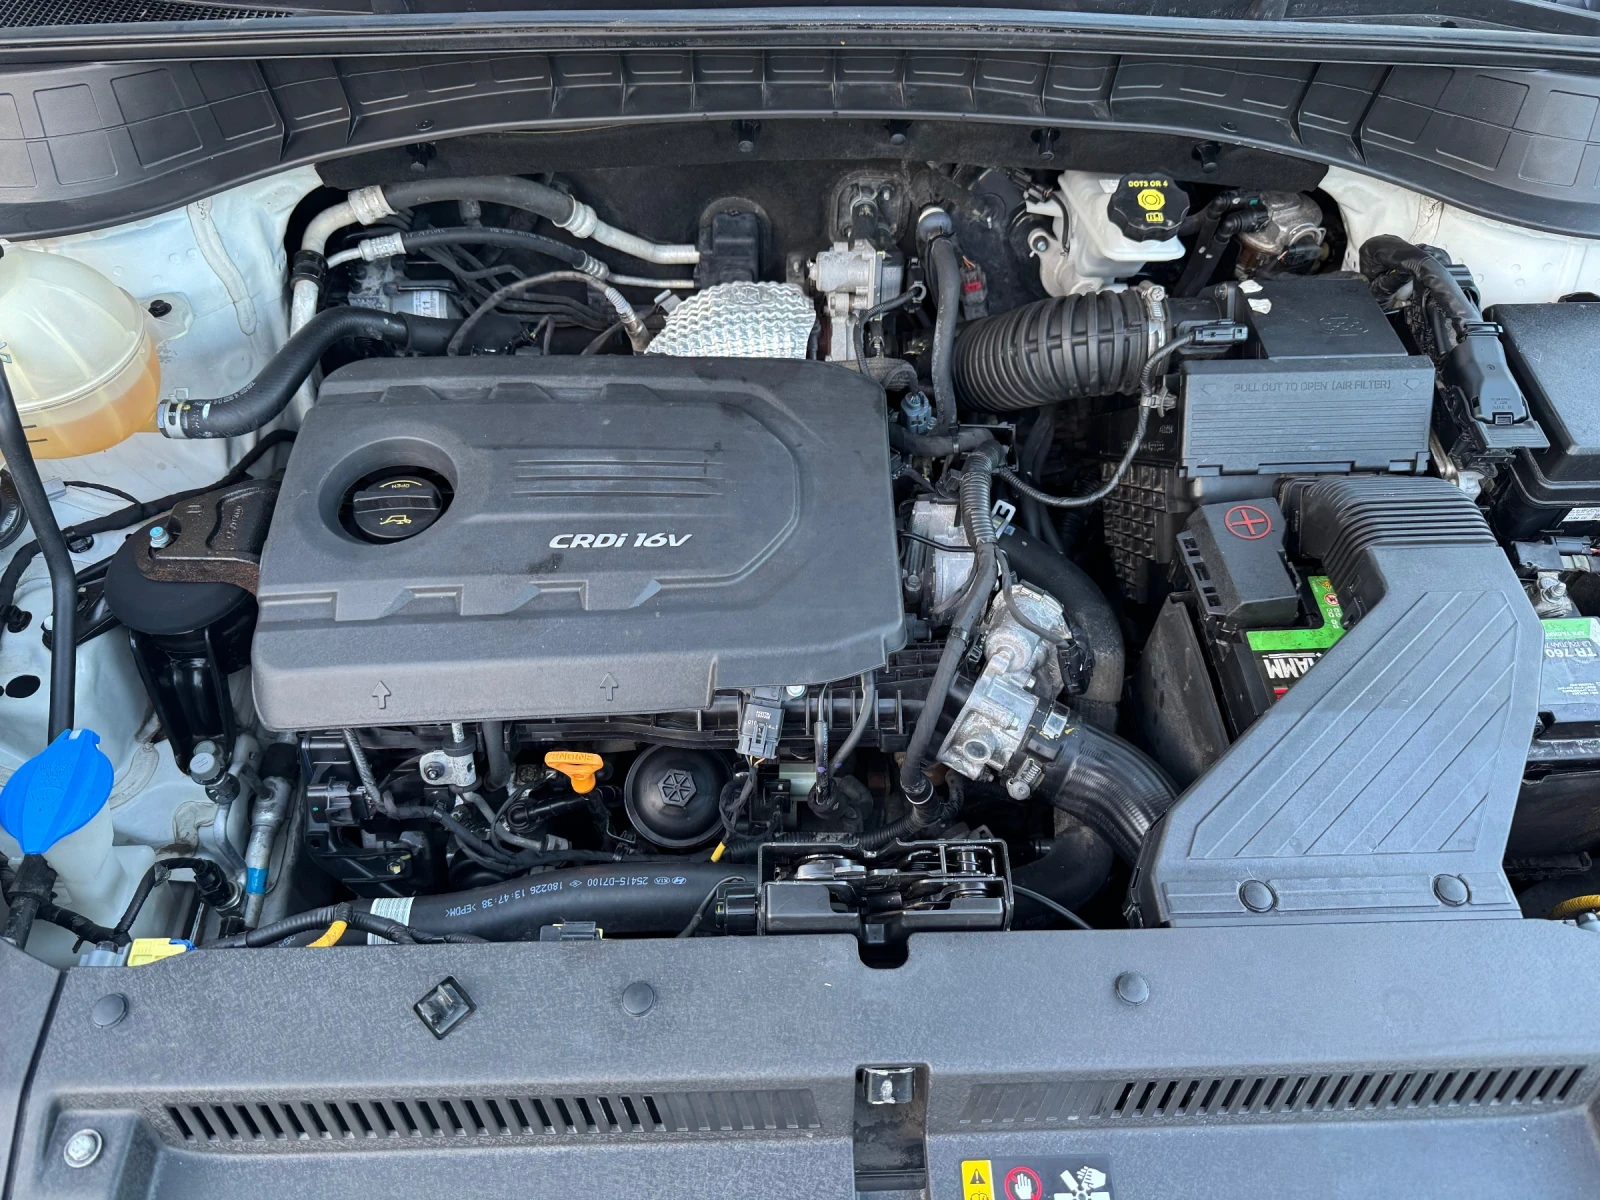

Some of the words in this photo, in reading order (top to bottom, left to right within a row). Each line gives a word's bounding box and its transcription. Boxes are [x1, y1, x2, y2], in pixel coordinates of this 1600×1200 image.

[1128, 180, 1149, 188] DOT3
[1162, 180, 1168, 188] 4
[1234, 382, 1260, 393] PULL
[1262, 382, 1282, 392] OUT
[1285, 381, 1298, 392] TO
[1300, 381, 1327, 391] OPEN
[549, 532, 629, 549] CRDi
[634, 532, 693, 548] 16V
[1545, 648, 1573, 658] 760
[1575, 647, 1597, 657] TR
[551, 752, 594, 761] ENGINE
[587, 876, 649, 887] 25415-D7100
[529, 881, 564, 895] 180226
[481, 888, 525, 909] 13:47:38
